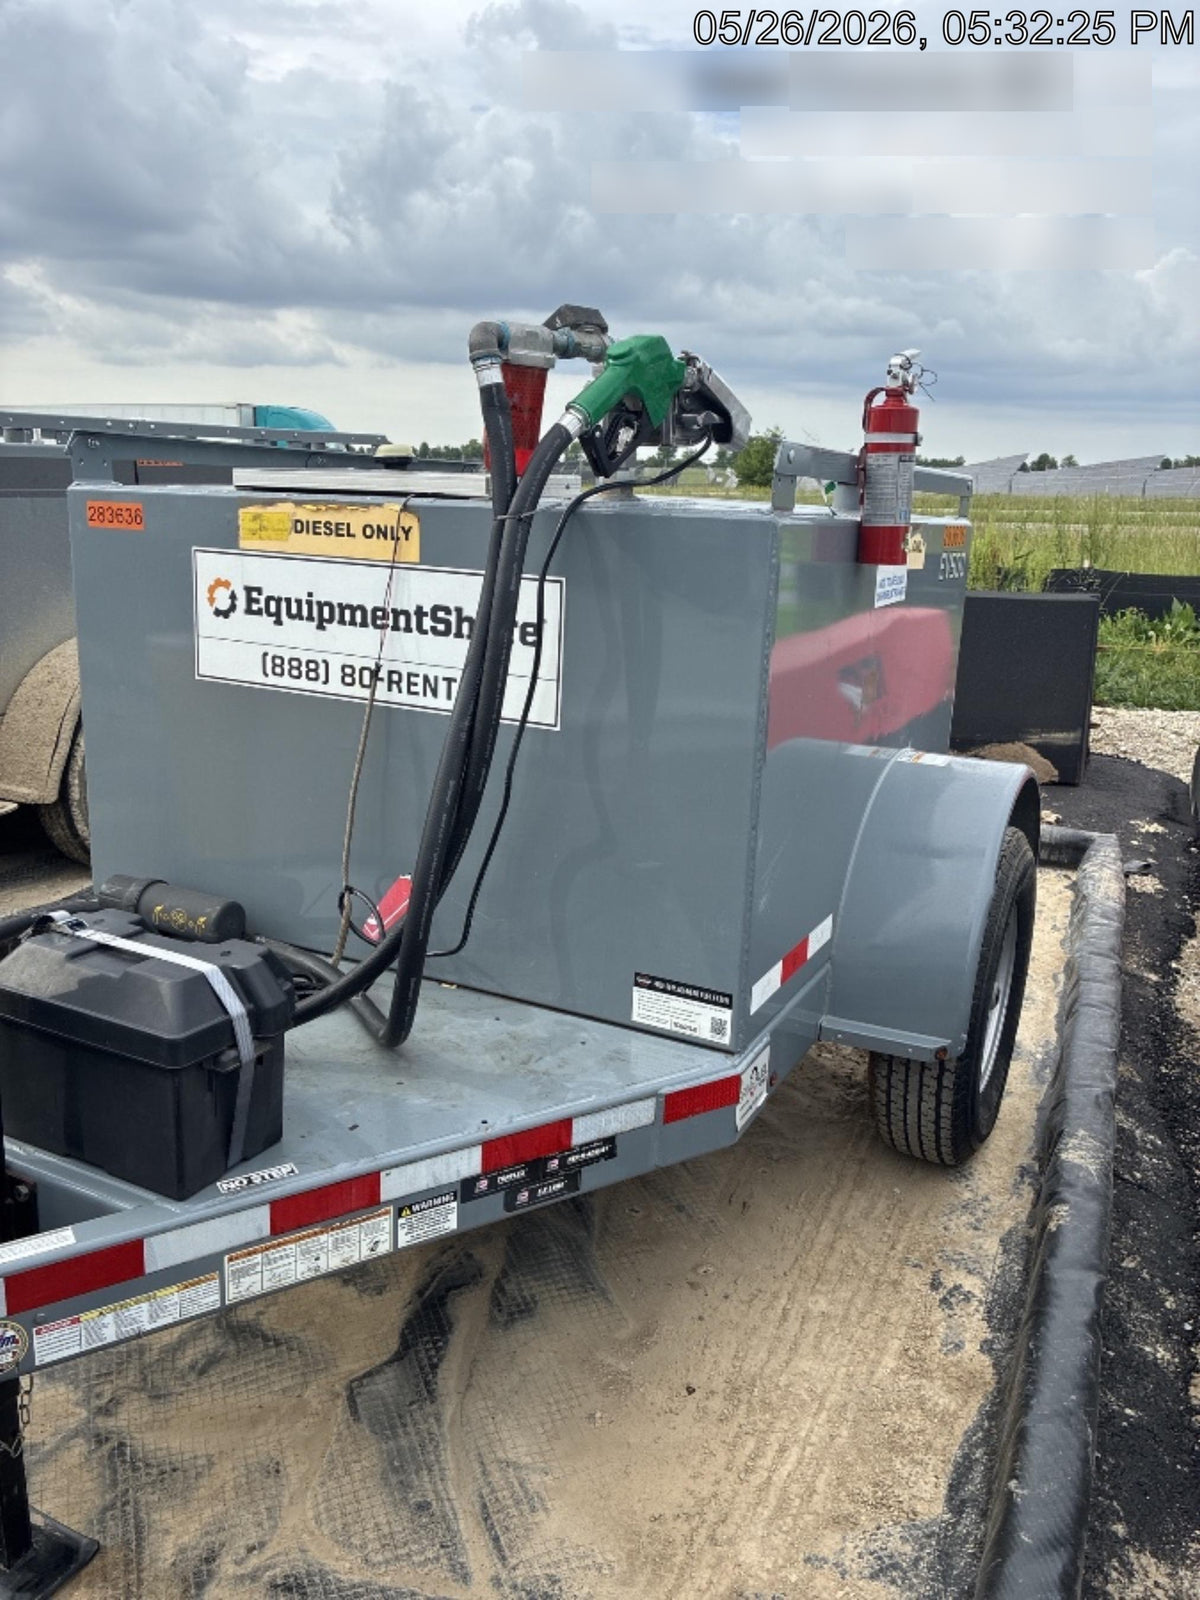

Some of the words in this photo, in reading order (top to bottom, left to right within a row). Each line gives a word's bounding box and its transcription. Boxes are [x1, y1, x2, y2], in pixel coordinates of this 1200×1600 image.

[88, 505, 143, 526] 283636
[293, 518, 356, 538] DIESEL
[362, 523, 414, 542] ONLY
[244, 585, 543, 648] EquipmentShe
[261, 652, 330, 685] (888)
[341, 663, 458, 701] 80-RENT
[221, 1178, 248, 1191] NO
[411, 1193, 455, 1212] WARNING
